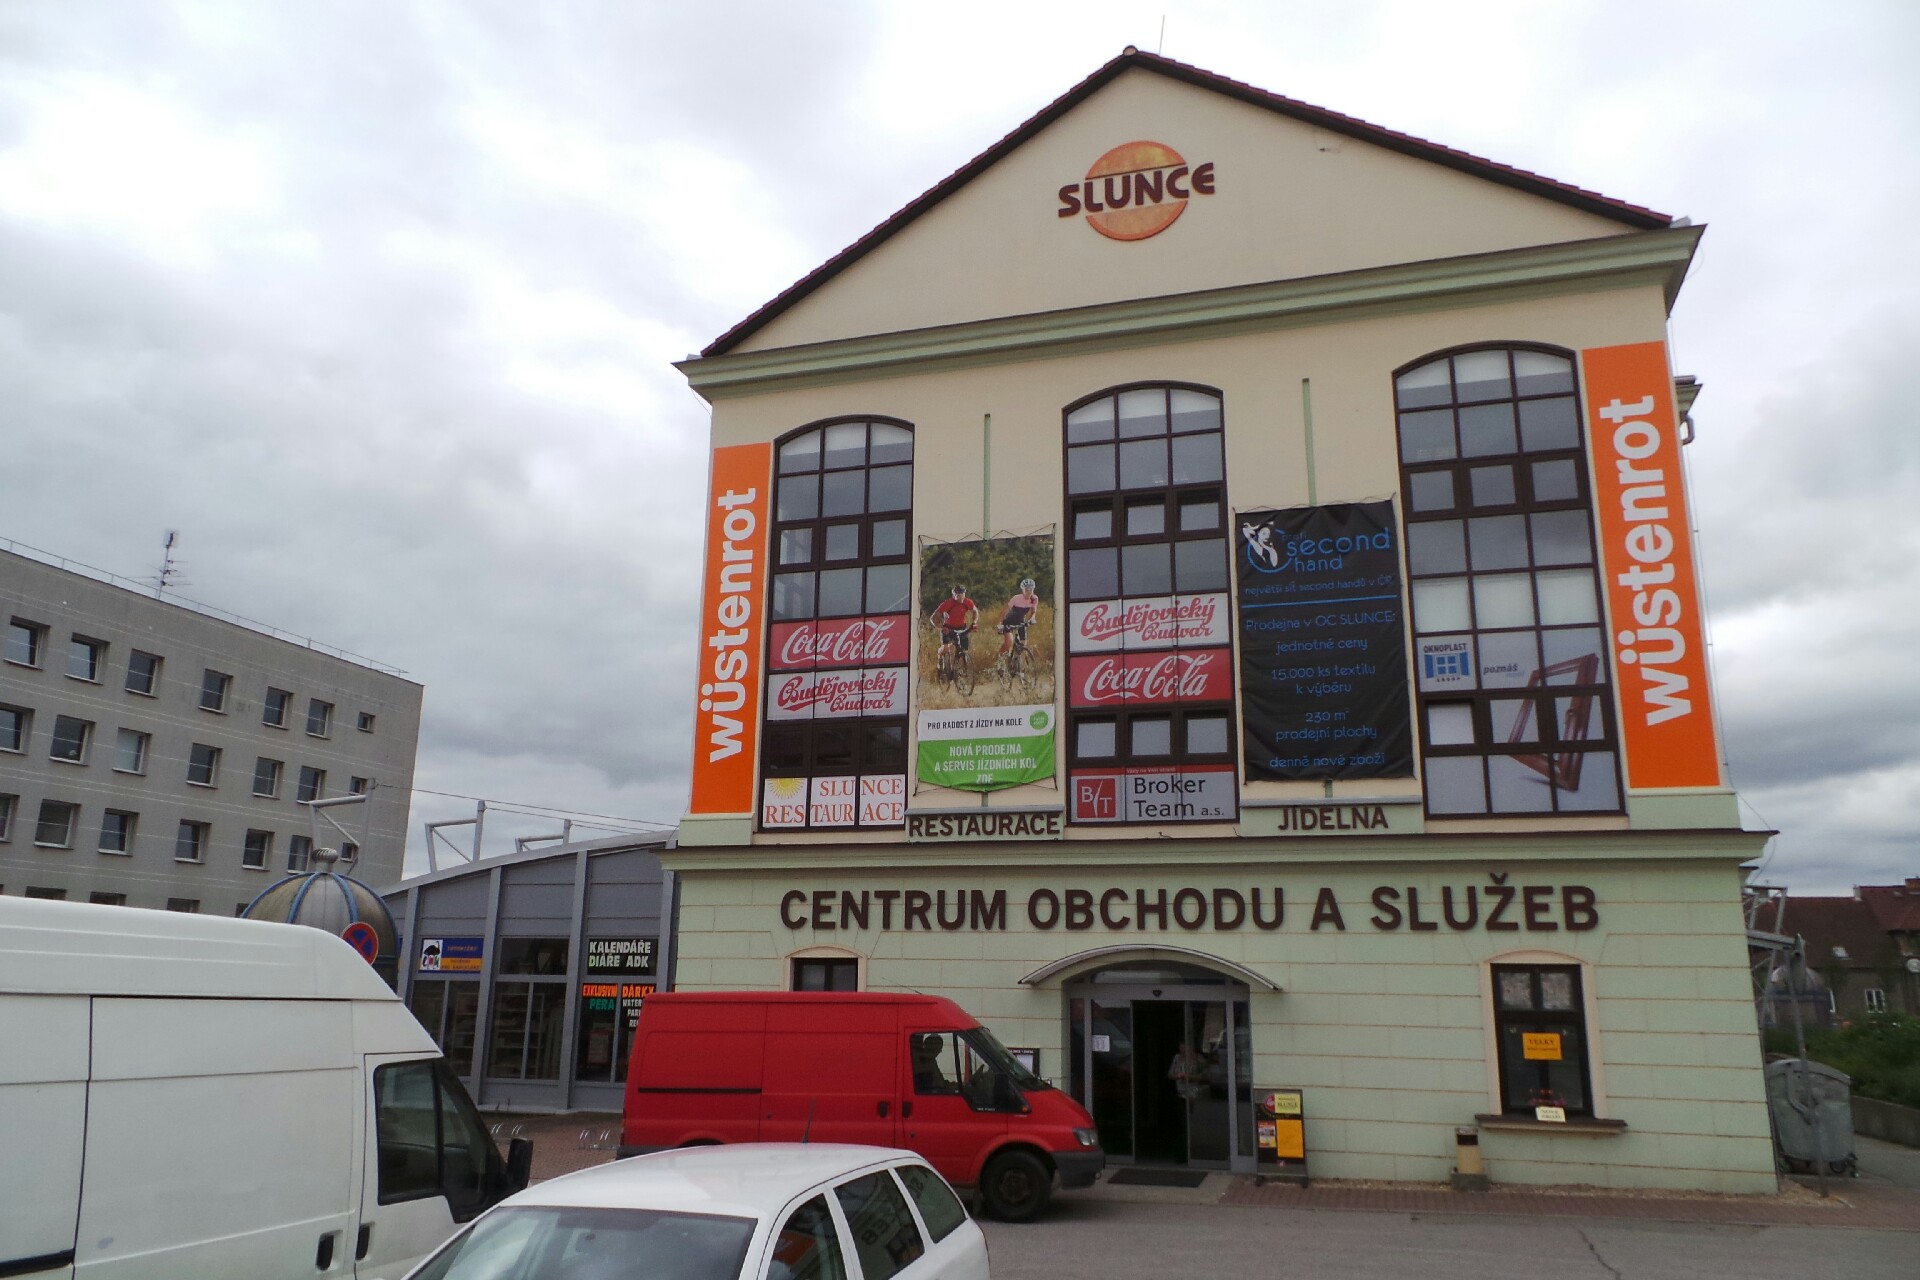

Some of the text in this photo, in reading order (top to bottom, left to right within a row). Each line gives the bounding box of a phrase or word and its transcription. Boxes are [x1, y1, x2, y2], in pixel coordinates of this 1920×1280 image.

[1058, 162, 1215, 218] SLUNCE
[1286, 526, 1391, 557] second
[1295, 554, 1343, 572] hand
[1599, 395, 1692, 726] wüstenrot
[1299, 581, 1335, 591] second
[700, 487, 756, 763] wüstenrot
[1080, 597, 1216, 642] Budějovický
[1246, 618, 1300, 632] Prodejna
[1303, 618, 1313, 627] v
[1315, 614, 1337, 626] OC
[782, 619, 896, 664] Coca-Cola
[1276, 638, 1368, 656] jednotné ceny
[1423, 642, 1467, 654] OKNOPLAST
[1083, 653, 1214, 701] Coca-Cola
[1271, 663, 1376, 681] 15.000 ks textilu
[777, 671, 897, 712] Budějovický
[1295, 682, 1352, 696] k výběru
[927, 721, 941, 730] PRO
[942, 719, 968, 729] RADOST
[969, 720, 974, 728] Z
[975, 718, 993, 728] JÍZDY
[994, 718, 1004, 727] NA
[1005, 717, 1023, 726] KOLE
[1305, 711, 1331, 724] 230
[1276, 726, 1330, 743] prodejní
[949, 743, 1022, 757] NOVÁ PRODEJNA
[934, 757, 1037, 772] A SERVIS JÍZDNÍCH KOL
[1269, 755, 1309, 768] denně
[1313, 754, 1346, 766] nové
[1133, 775, 1206, 795] Broker
[1133, 800, 1224, 817] Team a.s.
[909, 813, 1061, 837] RESTAURACE
[780, 872, 1600, 932] CENTRUM OBCHODU A SLUŽEB
[589, 939, 651, 954] KALENDÁŘE
[588, 953, 649, 968] DIÁŘE ADK
[589, 998, 615, 1010] PERA
